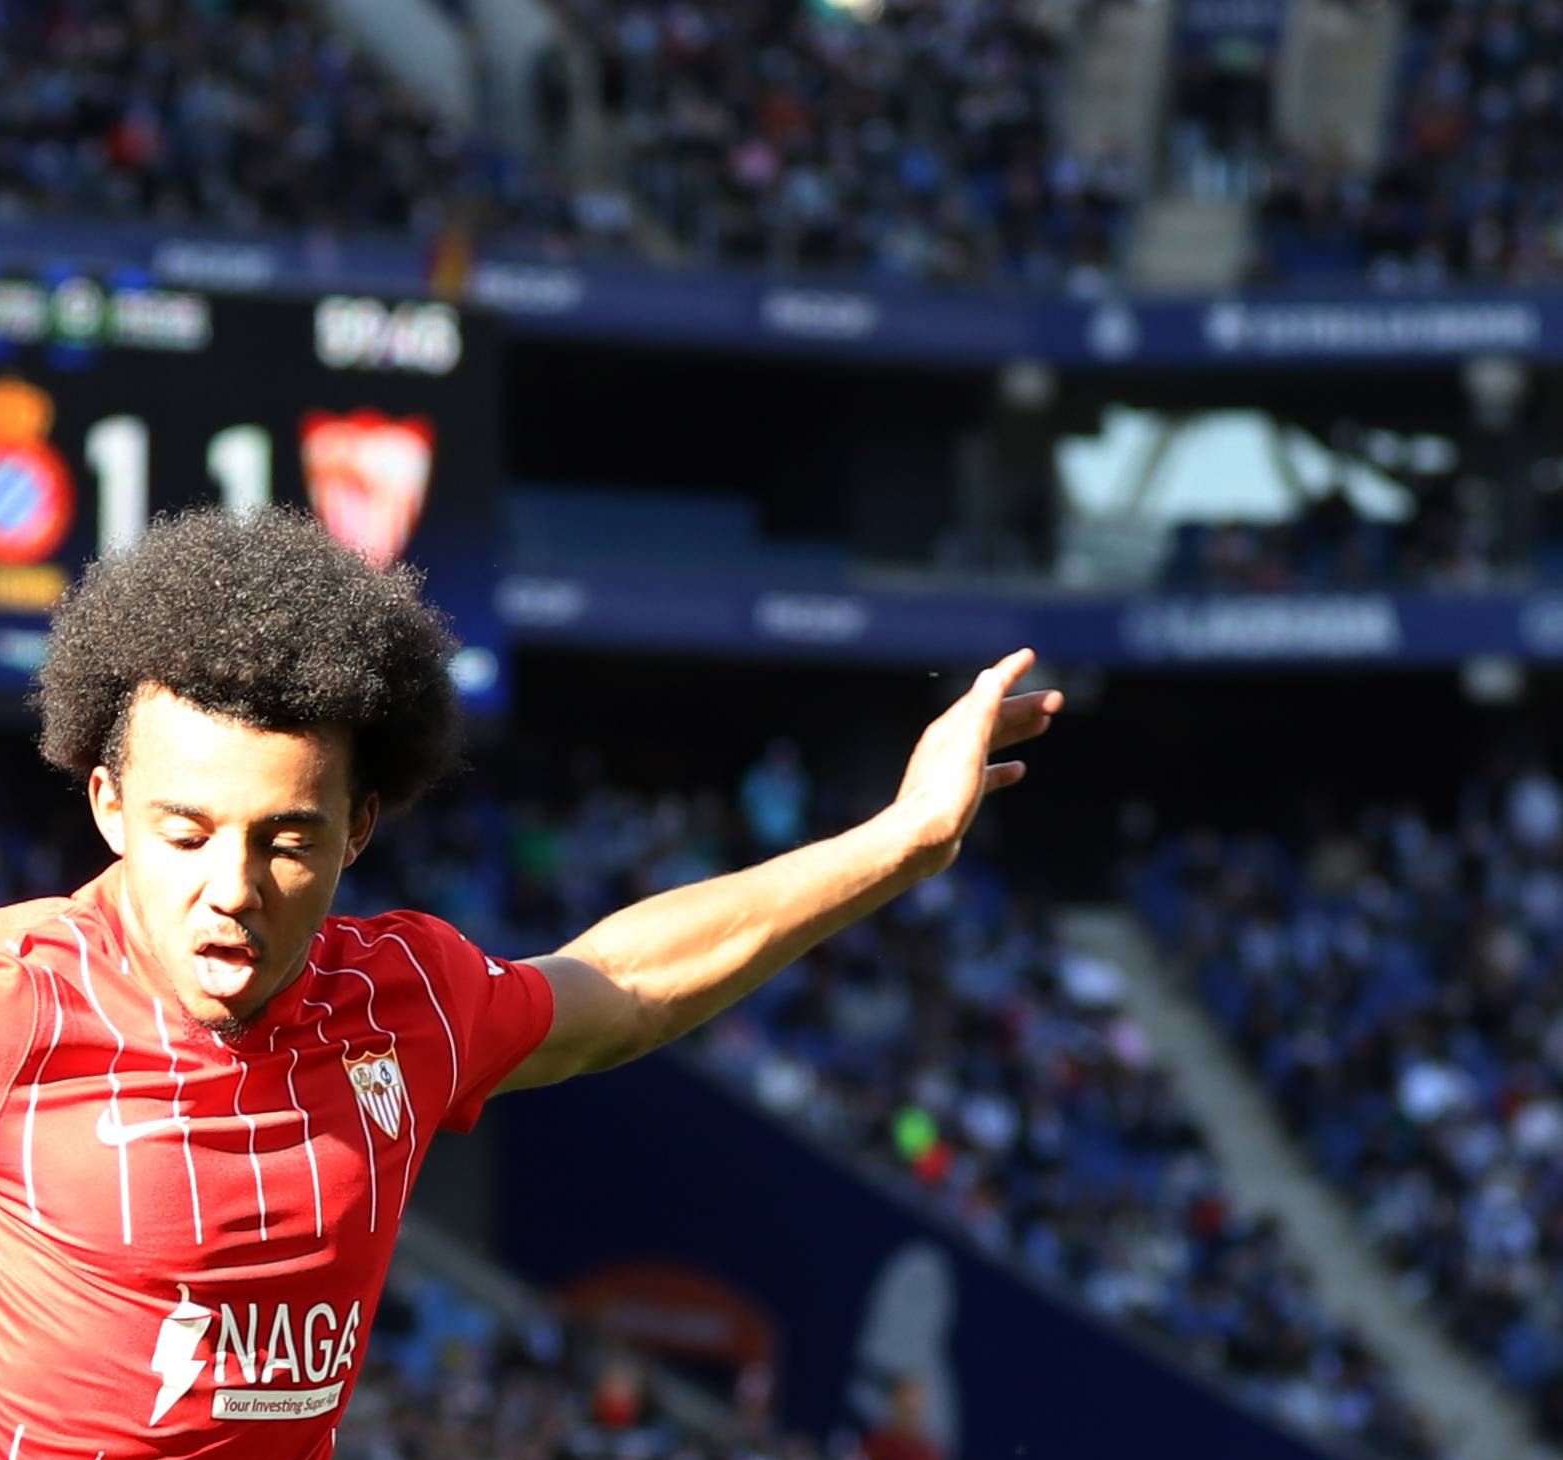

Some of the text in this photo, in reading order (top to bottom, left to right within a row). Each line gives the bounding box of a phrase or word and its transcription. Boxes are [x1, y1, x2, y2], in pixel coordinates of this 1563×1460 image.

[85, 414, 273, 562] 1 1
[214, 1301, 360, 1384] NAGA
[223, 1397, 251, 1412] Your
[252, 1398, 303, 1414] Investing
